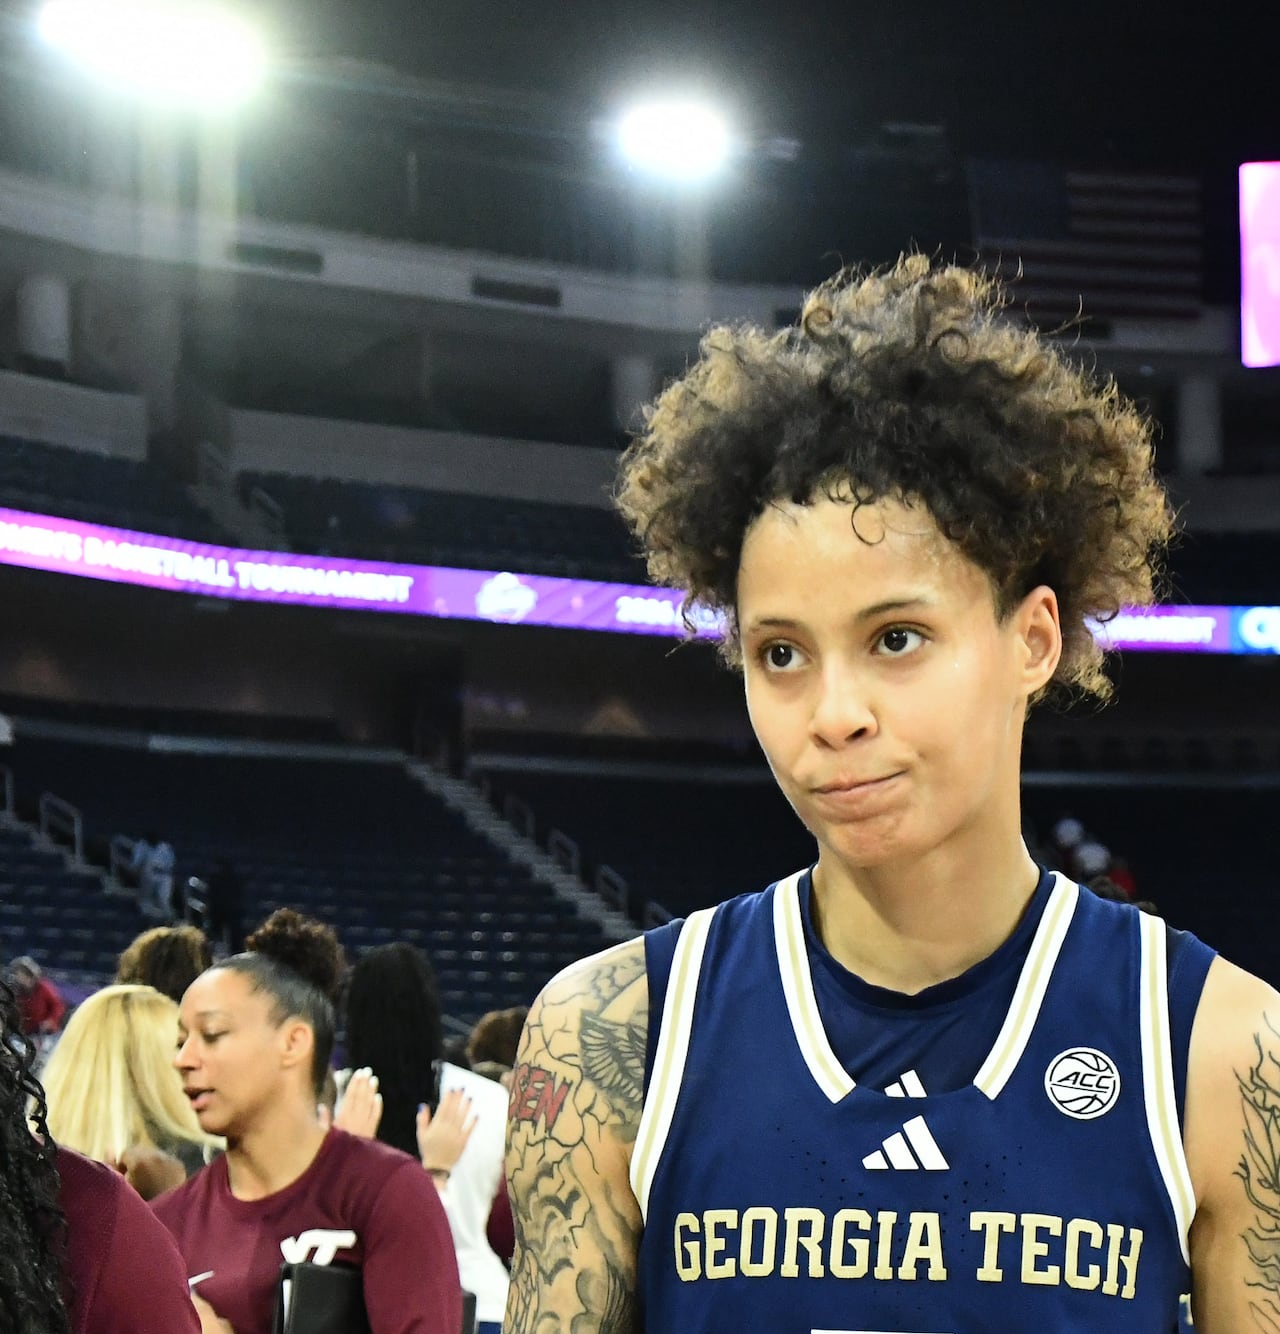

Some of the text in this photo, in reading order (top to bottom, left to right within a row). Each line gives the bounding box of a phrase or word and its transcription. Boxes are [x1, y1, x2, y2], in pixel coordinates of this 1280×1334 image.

[1057, 1071, 1115, 1090] ACC
[280, 1228, 357, 1267] VT
[674, 1206, 1144, 1300] GEORGIA TECH
